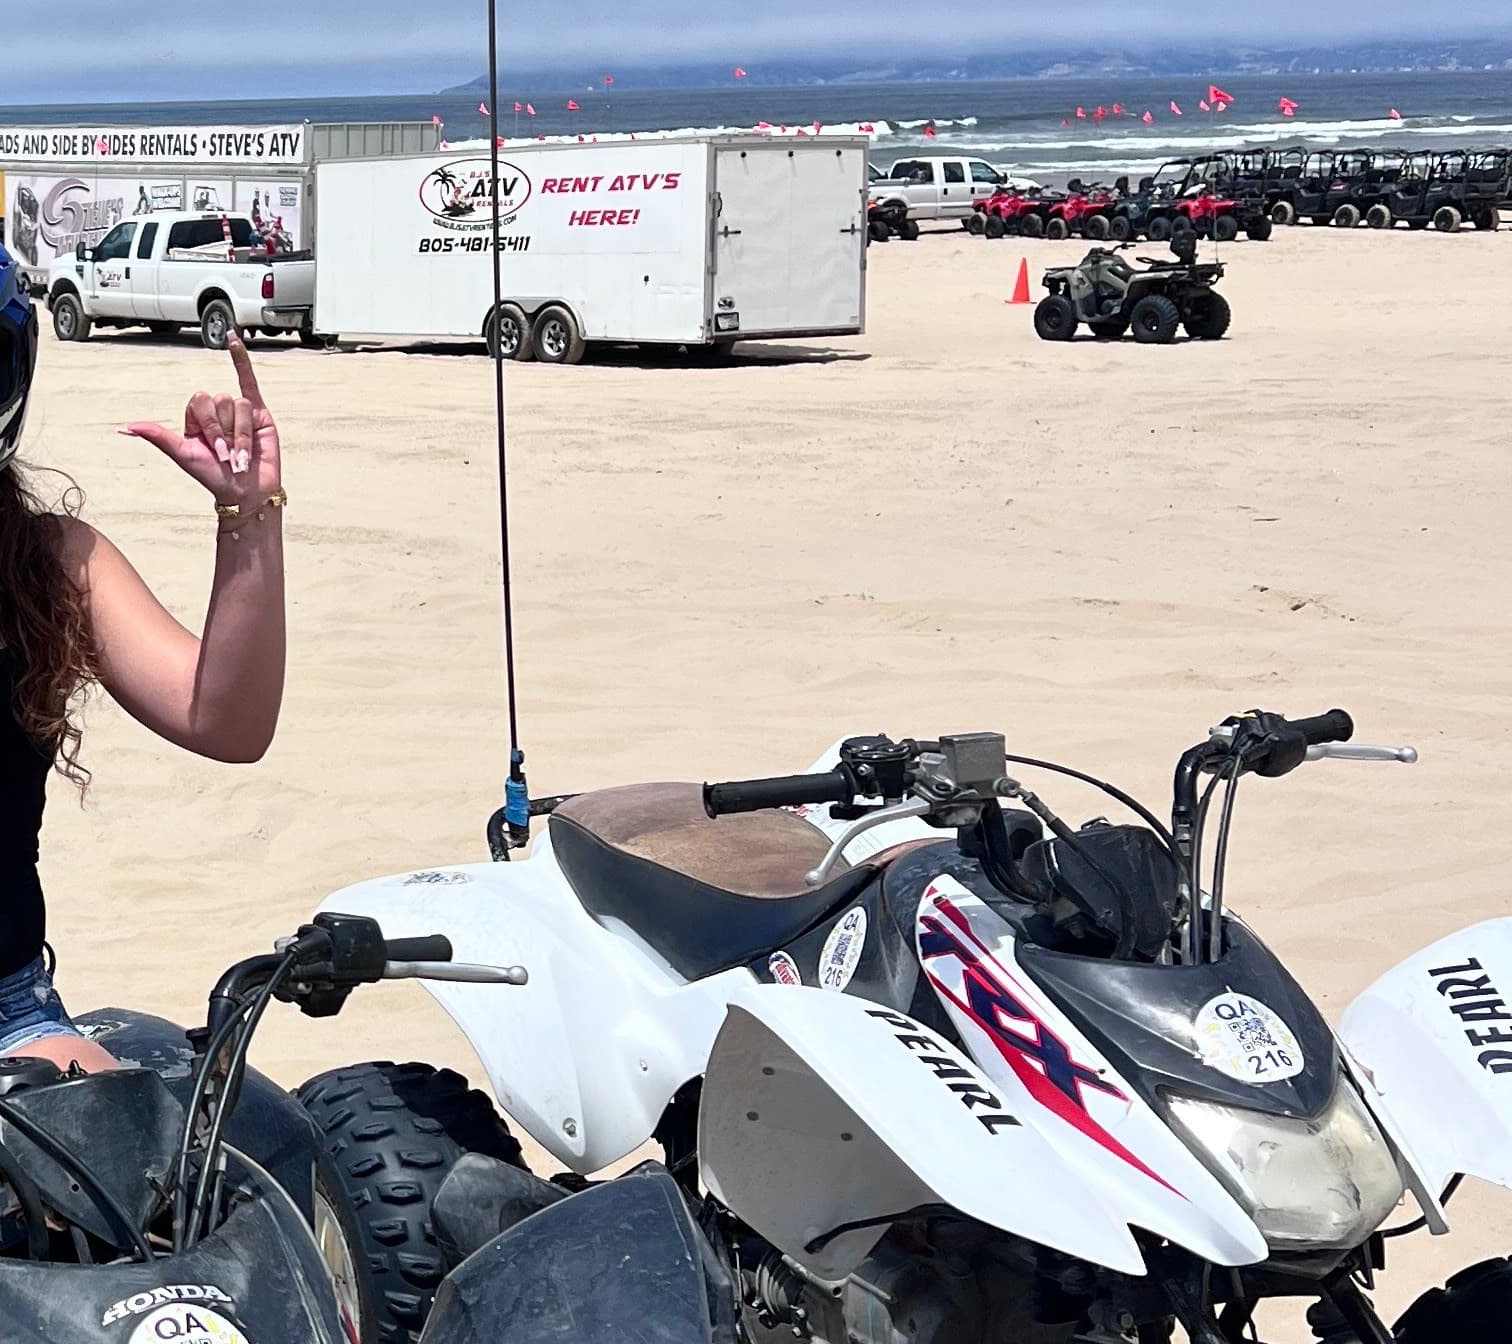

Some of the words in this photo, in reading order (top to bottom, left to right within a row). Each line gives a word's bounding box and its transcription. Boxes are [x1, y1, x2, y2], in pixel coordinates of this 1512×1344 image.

[23, 134, 48, 155] AND
[52, 134, 78, 156] SIDE
[81, 134, 97, 156] BY
[99, 134, 136, 156] SIDES
[140, 134, 197, 156] RENTALS
[209, 133, 265, 156] STEVE'S
[269, 133, 300, 156] ATV
[471, 177, 519, 197] ATV
[541, 176, 604, 194] RENT
[608, 172, 682, 192] ATV'S
[476, 199, 514, 207] RENALS
[568, 209, 640, 226] HERE!
[419, 236, 531, 253] 805-481-5411
[843, 913, 860, 931] QA
[825, 967, 843, 987] 216
[1215, 1000, 1257, 1020] QA
[1248, 1050, 1292, 1074] 216
[864, 1010, 1023, 1135] PEARL
[101, 1284, 232, 1327] HONDA
[154, 1312, 209, 1340] QA
